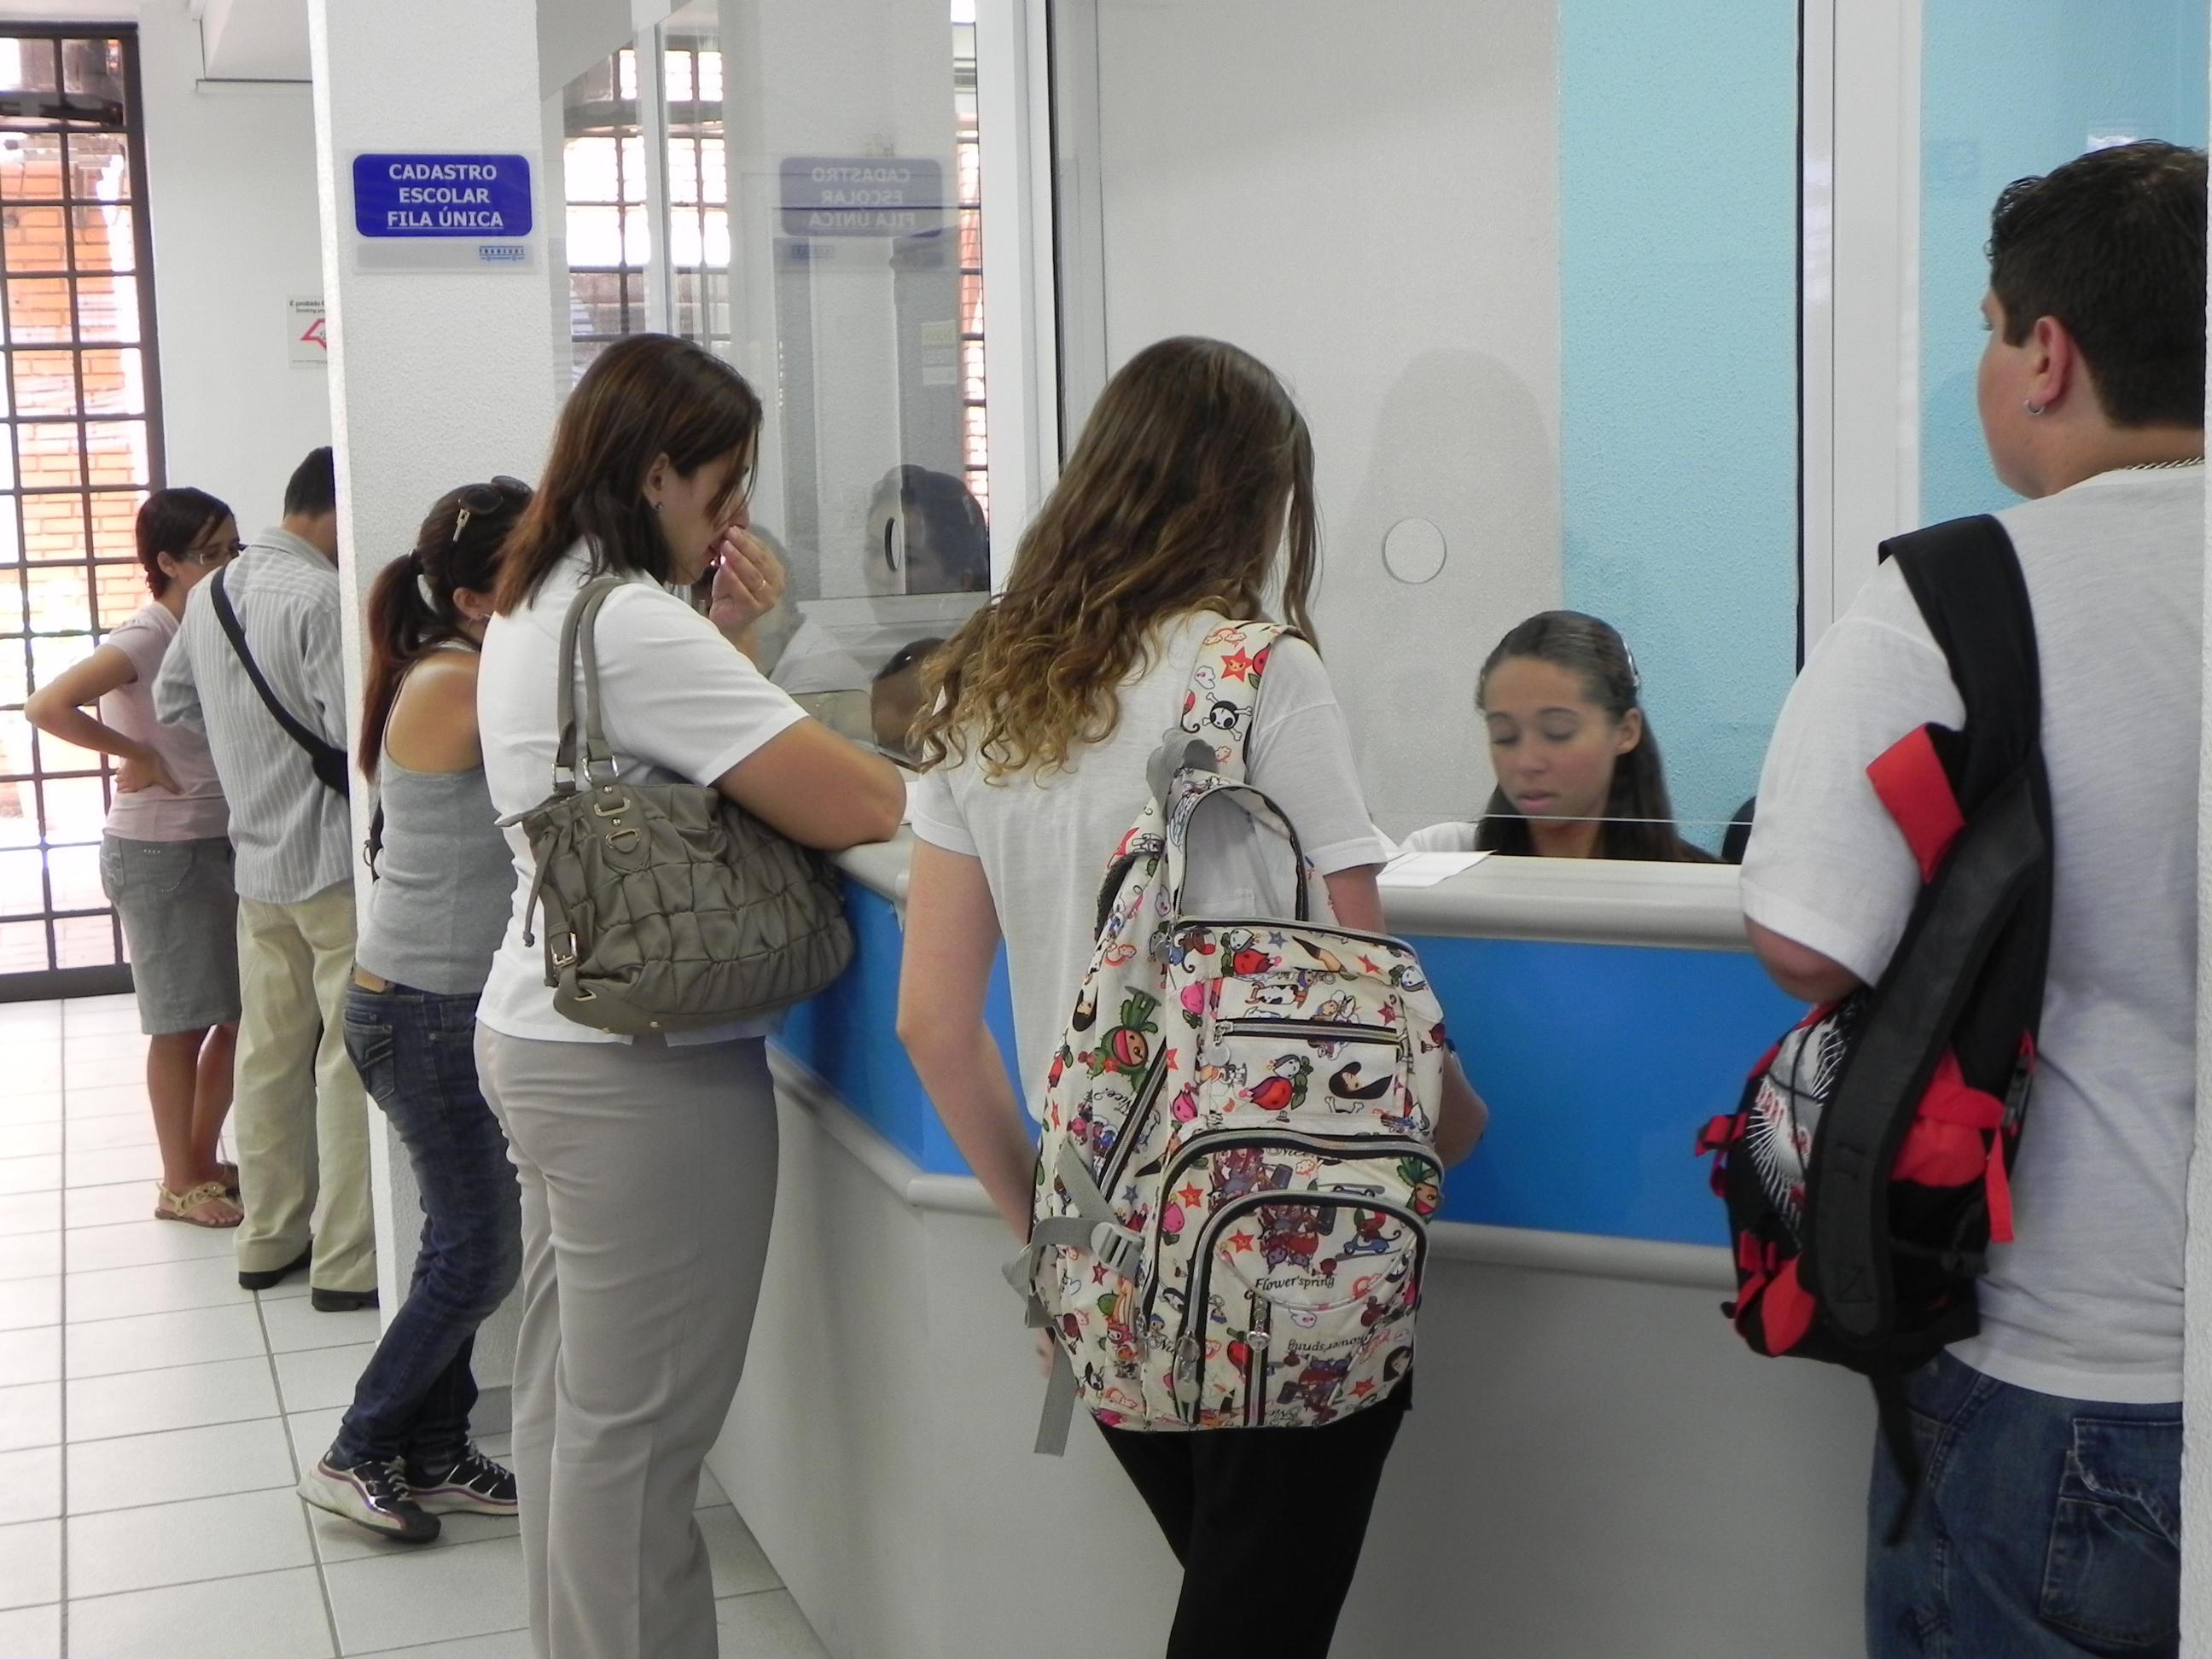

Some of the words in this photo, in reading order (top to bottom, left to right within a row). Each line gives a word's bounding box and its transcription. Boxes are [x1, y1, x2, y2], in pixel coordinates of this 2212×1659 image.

[388, 163, 498, 180] CADASTRO
[399, 187, 491, 203] ESCOLAR
[387, 211, 433, 228] FILA
[438, 206, 504, 228] ÚNICA
